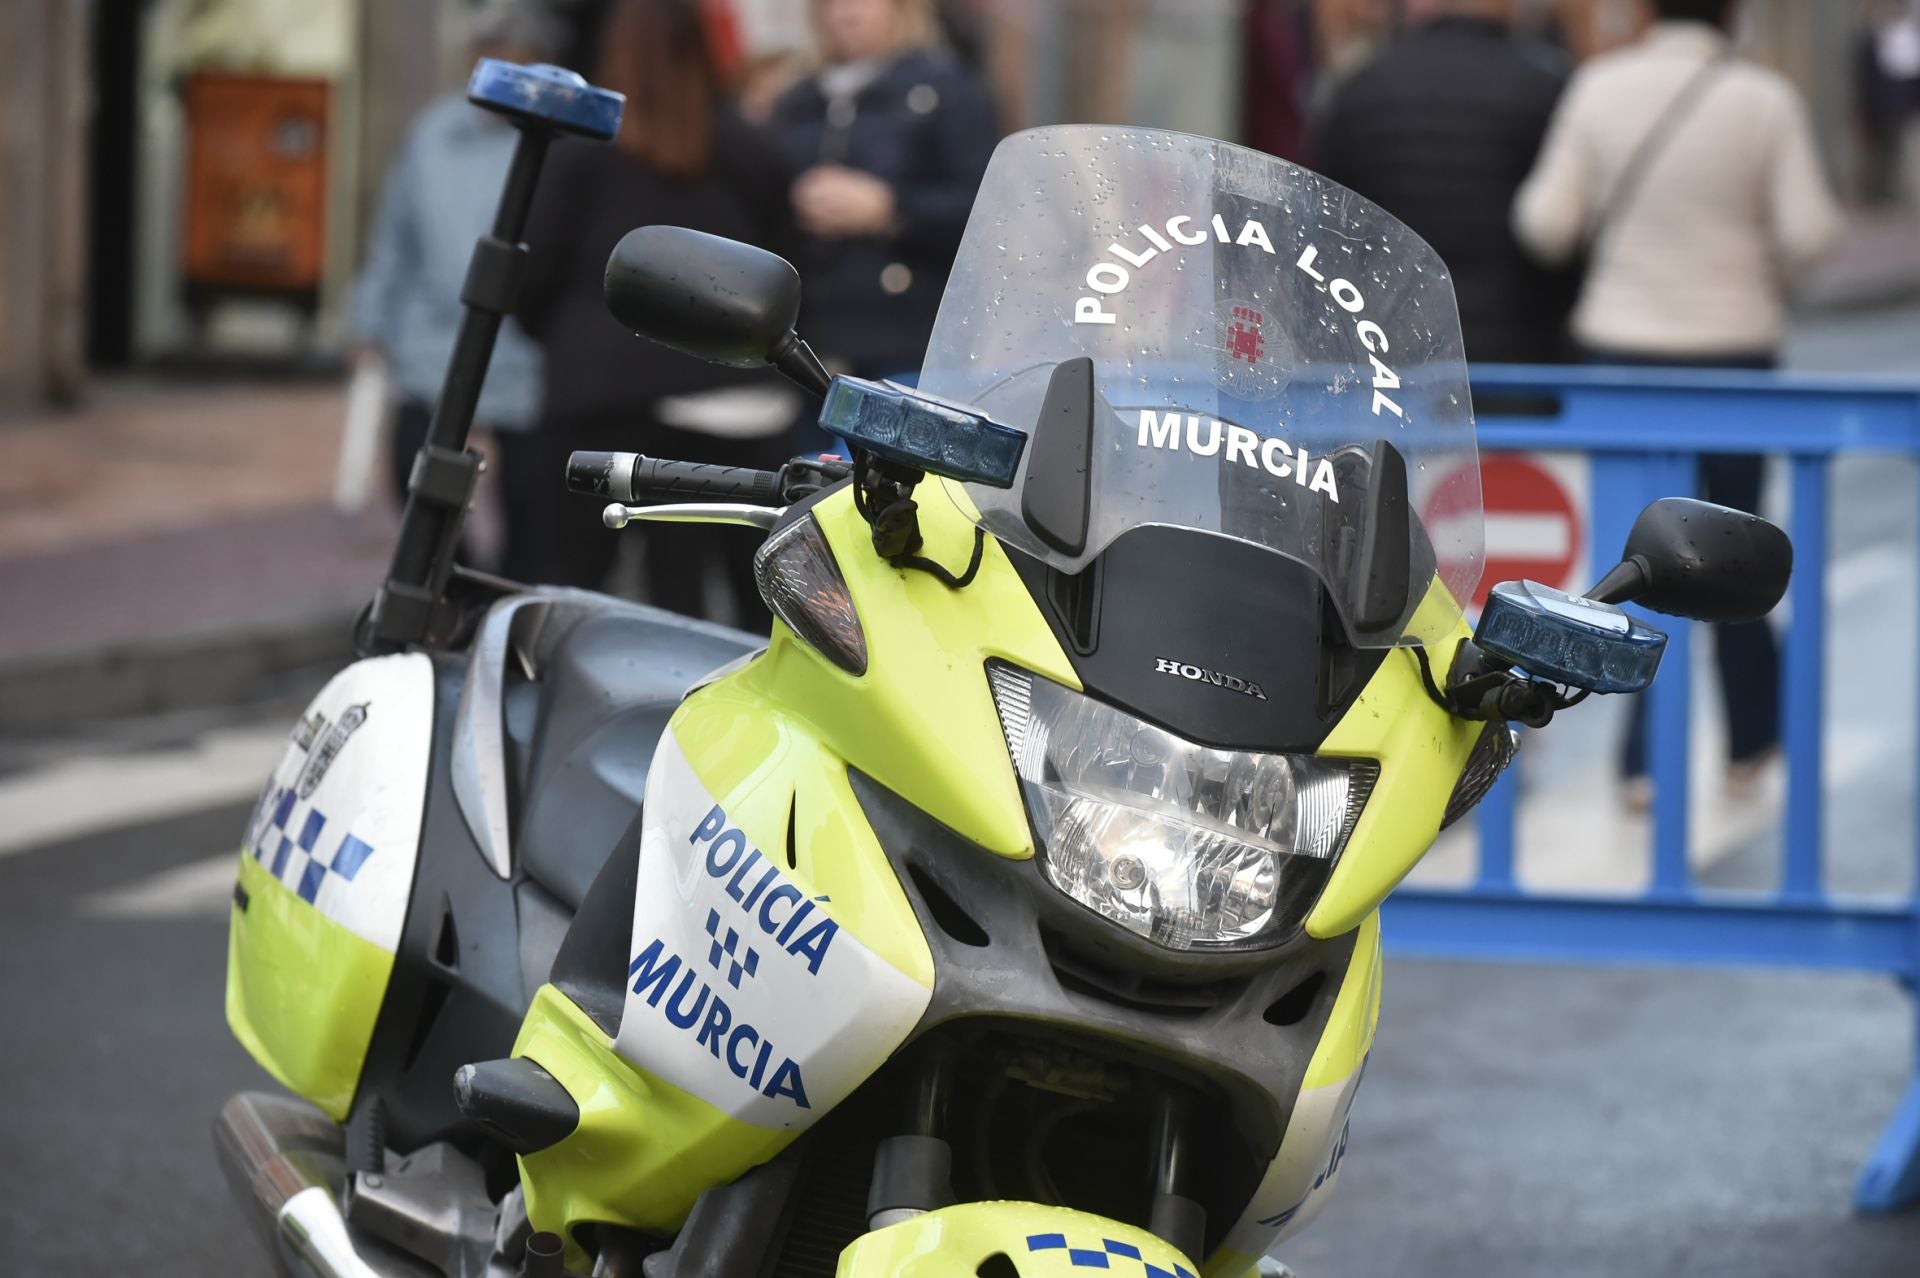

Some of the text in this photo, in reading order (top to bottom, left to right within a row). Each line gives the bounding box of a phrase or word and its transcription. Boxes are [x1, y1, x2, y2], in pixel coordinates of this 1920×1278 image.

[1075, 214, 1403, 418] POLICIA LOCAL
[1137, 409, 1340, 504] MURCIA
[1155, 657, 1268, 700] HONDA
[689, 804, 839, 976] POLICÍA
[628, 938, 811, 1109] MURCIA
